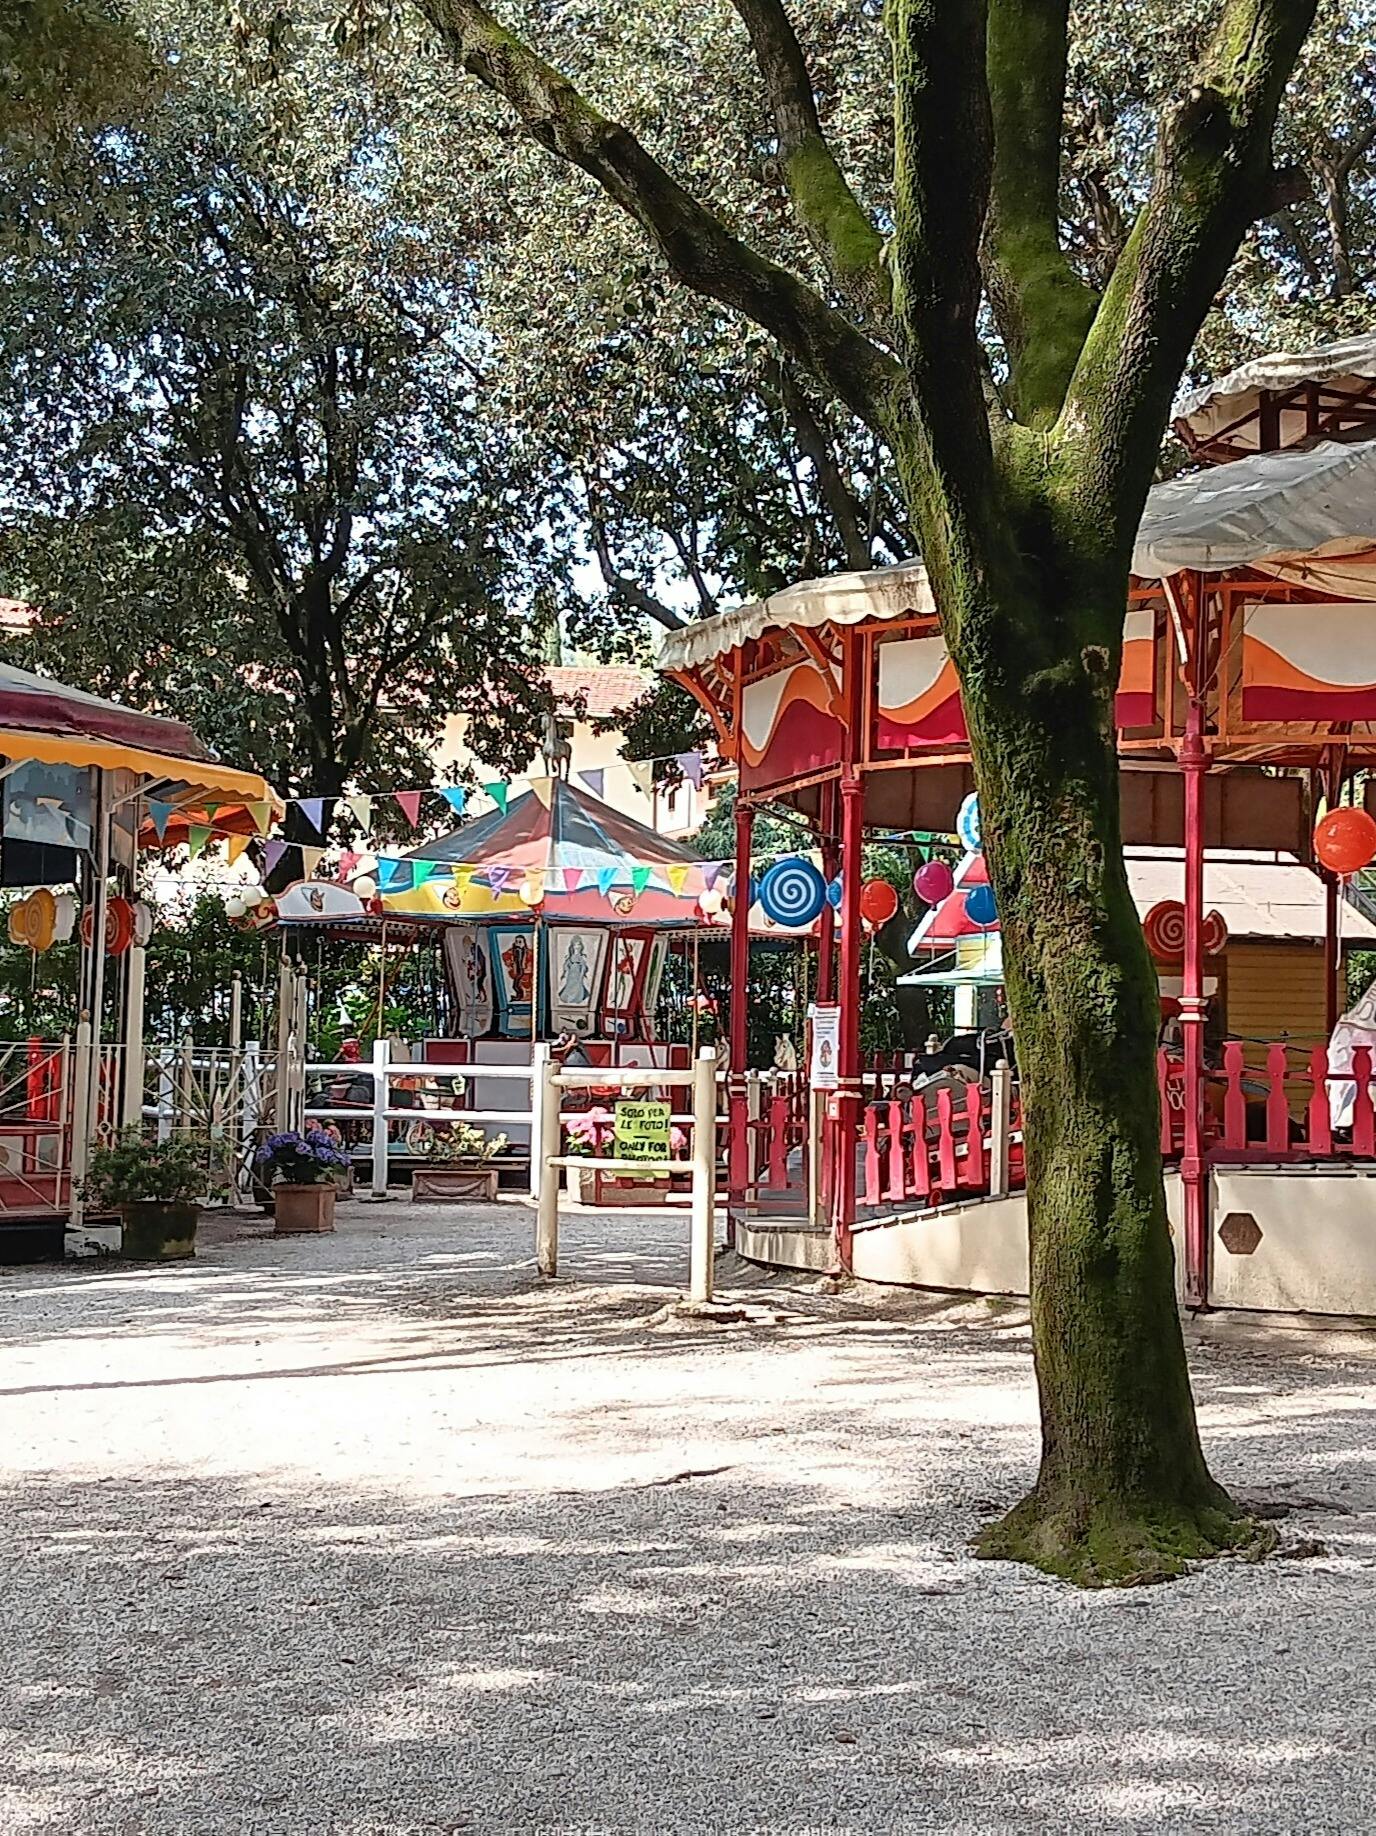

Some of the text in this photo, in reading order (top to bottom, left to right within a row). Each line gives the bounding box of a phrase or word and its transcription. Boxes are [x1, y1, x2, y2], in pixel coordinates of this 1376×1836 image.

[620, 1107, 665, 1118] SOLO PER
[620, 1119, 668, 1132] LE FOTO!
[620, 1142, 667, 1152] ONLY FOR
